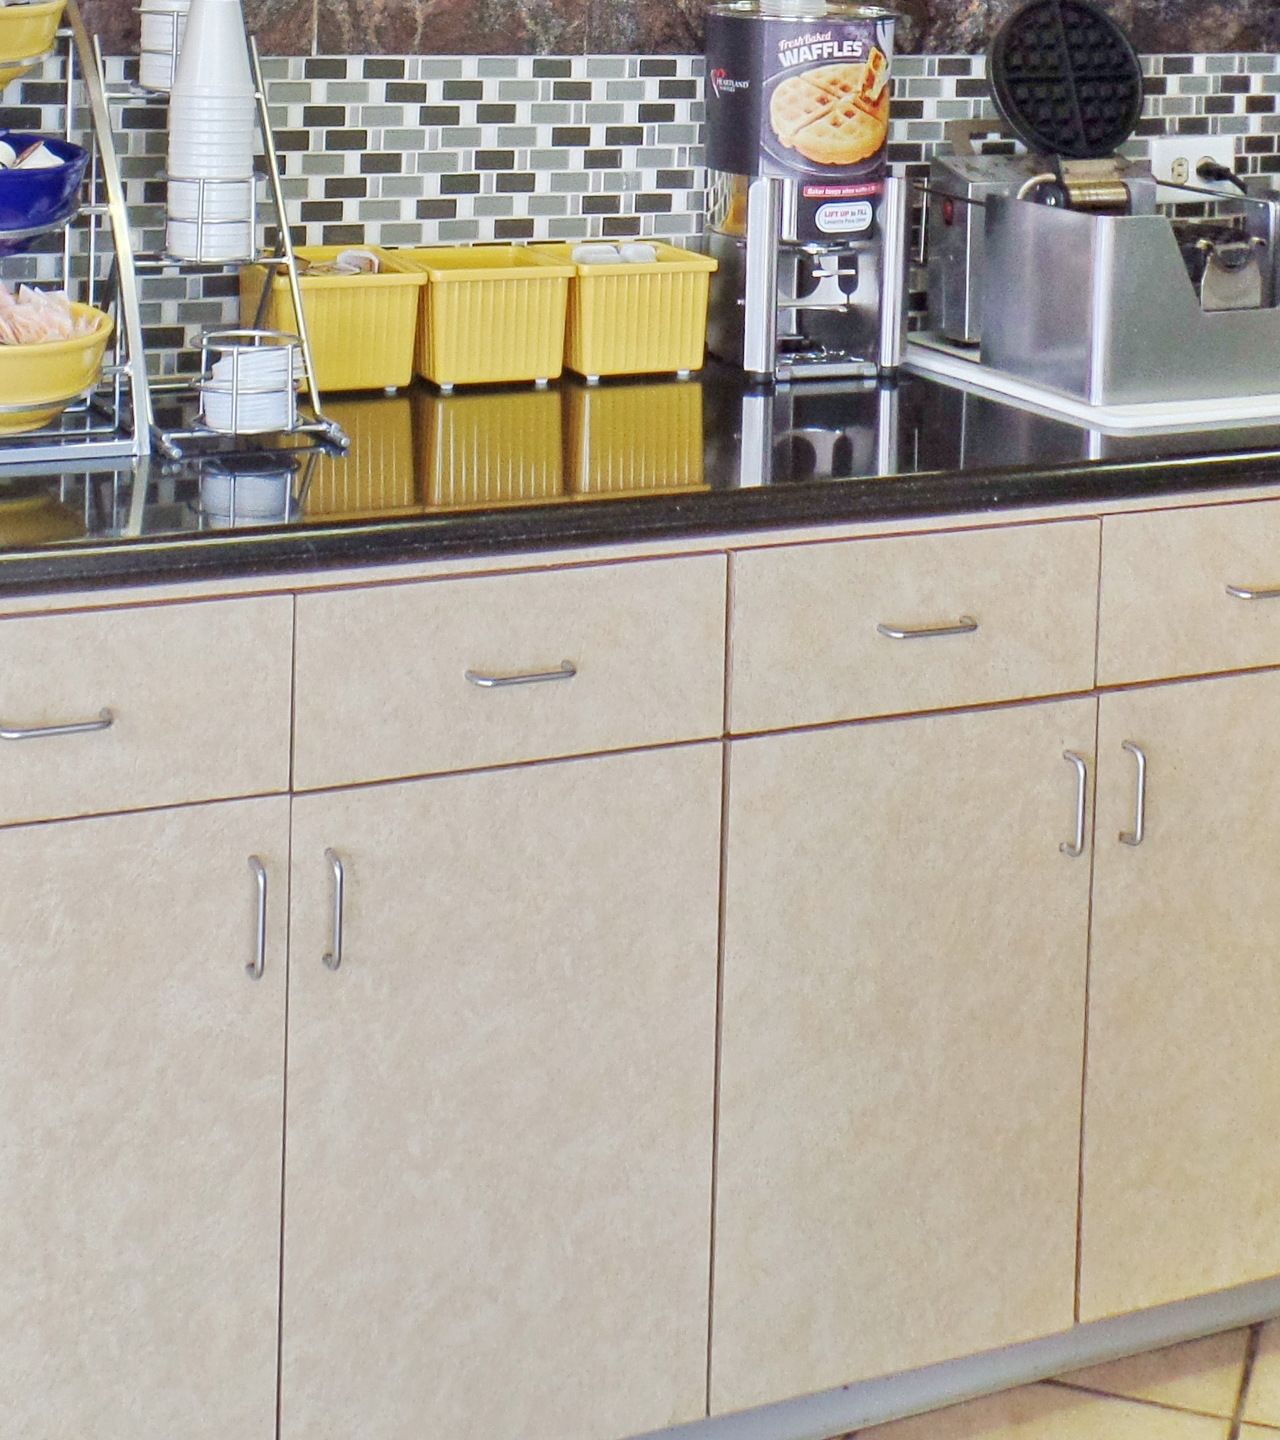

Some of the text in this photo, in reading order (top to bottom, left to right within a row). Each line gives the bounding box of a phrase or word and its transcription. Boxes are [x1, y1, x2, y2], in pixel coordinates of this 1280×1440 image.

[778, 31, 832, 51] Fresh Baked
[777, 41, 863, 68] WAFFLES
[824, 210, 839, 218] LIFT
